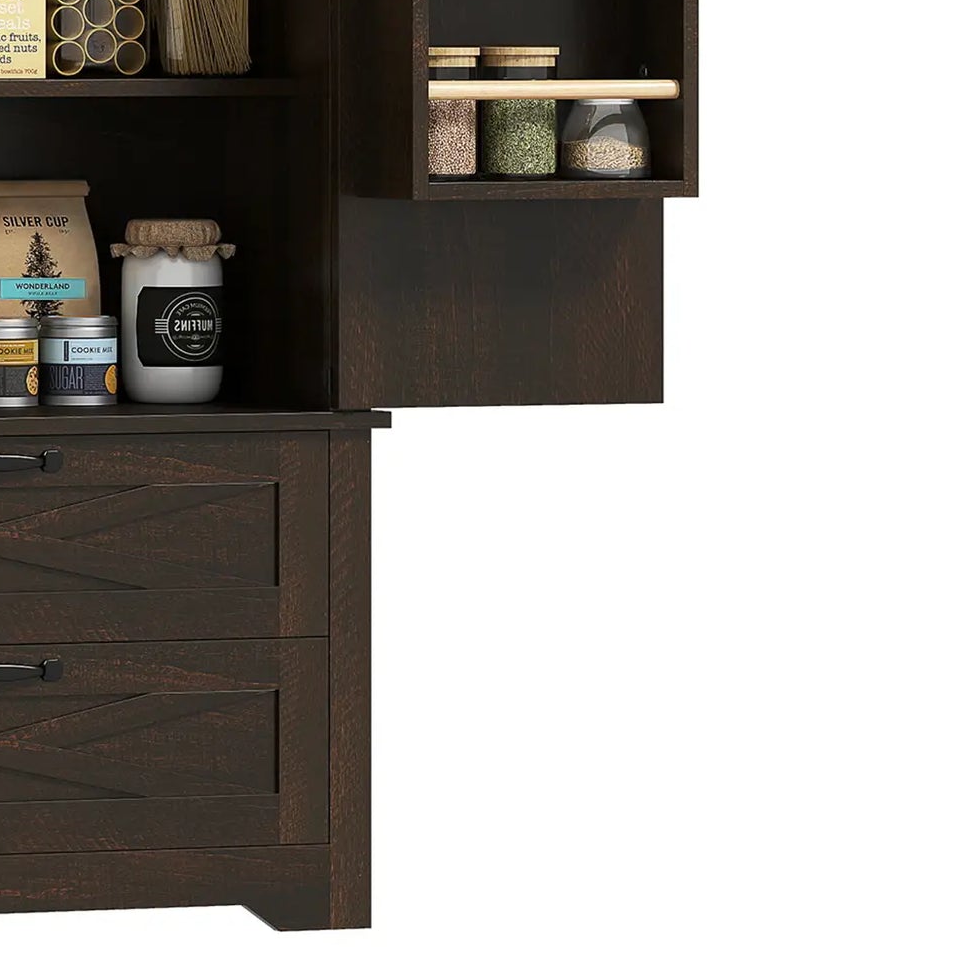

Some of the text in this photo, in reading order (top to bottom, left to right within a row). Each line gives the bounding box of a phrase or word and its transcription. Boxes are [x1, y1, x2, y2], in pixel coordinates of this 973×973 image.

[9, 32, 42, 43] fruits,
[14, 44, 38, 53] nuts
[2, 216, 69, 227] SILVER CUP
[24, 347, 34, 356] MIX
[71, 346, 113, 355] COOKIE MIX
[49, 365, 84, 390] SUGAR
